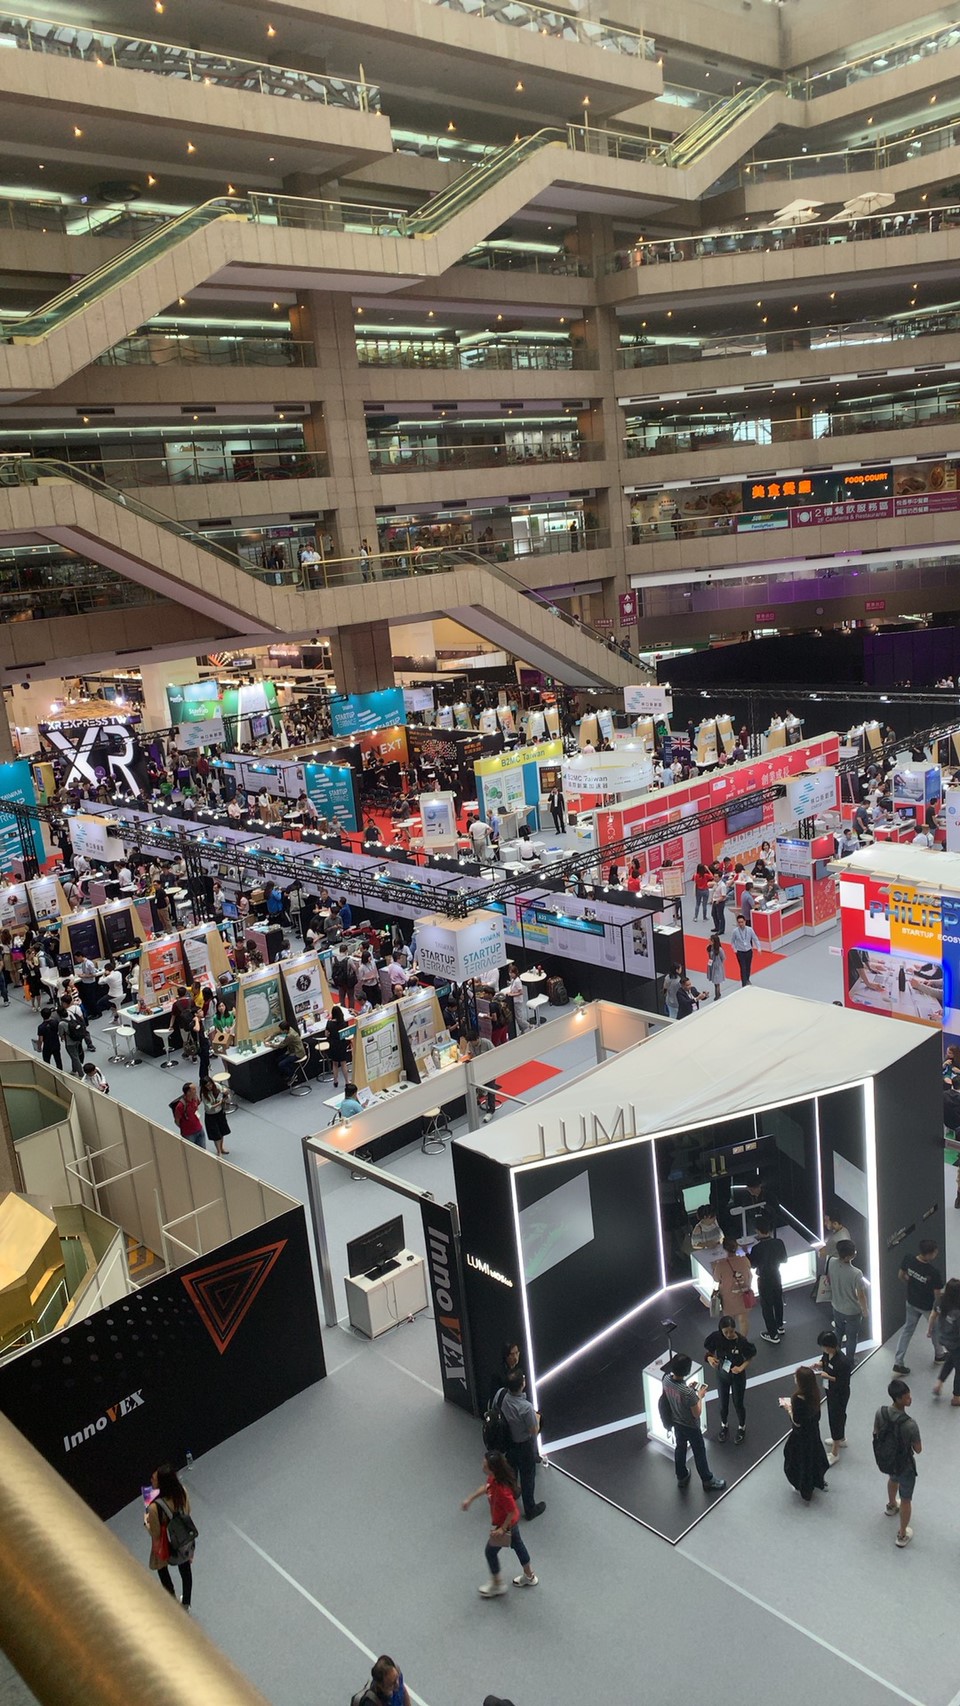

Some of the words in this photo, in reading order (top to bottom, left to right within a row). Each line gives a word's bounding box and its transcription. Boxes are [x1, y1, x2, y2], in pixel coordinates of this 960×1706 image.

[844, 475, 864, 485] FOOD
[865, 472, 889, 482] COURT
[751, 479, 813, 500] 美食餐廳
[825, 514, 850, 523] Cafeteria
[855, 511, 887, 519] Restaurants
[48, 721, 62, 731] XR
[63, 717, 109, 729] EXPRESS
[109, 715, 128, 725] TW
[335, 711, 356, 722] STARTUP
[46, 725, 141, 797] XR
[500, 755, 521, 767] B2MC
[522, 749, 545, 761] Taiwan
[329, 788, 348, 797] STARTUP
[480, 931, 501, 944] TAIWAN
[901, 927, 934, 939] STARTUP
[420, 948, 456, 965] STARTUP
[463, 942, 502, 966] STARTUP
[421, 958, 456, 977] TERRACE
[464, 952, 502, 976] TERRACE
[537, 1101, 637, 1160] LUMI
[466, 1253, 490, 1276] LUMI
[427, 1225, 468, 1391] InnoVEX
[63, 1388, 146, 1453] InnoVEX
